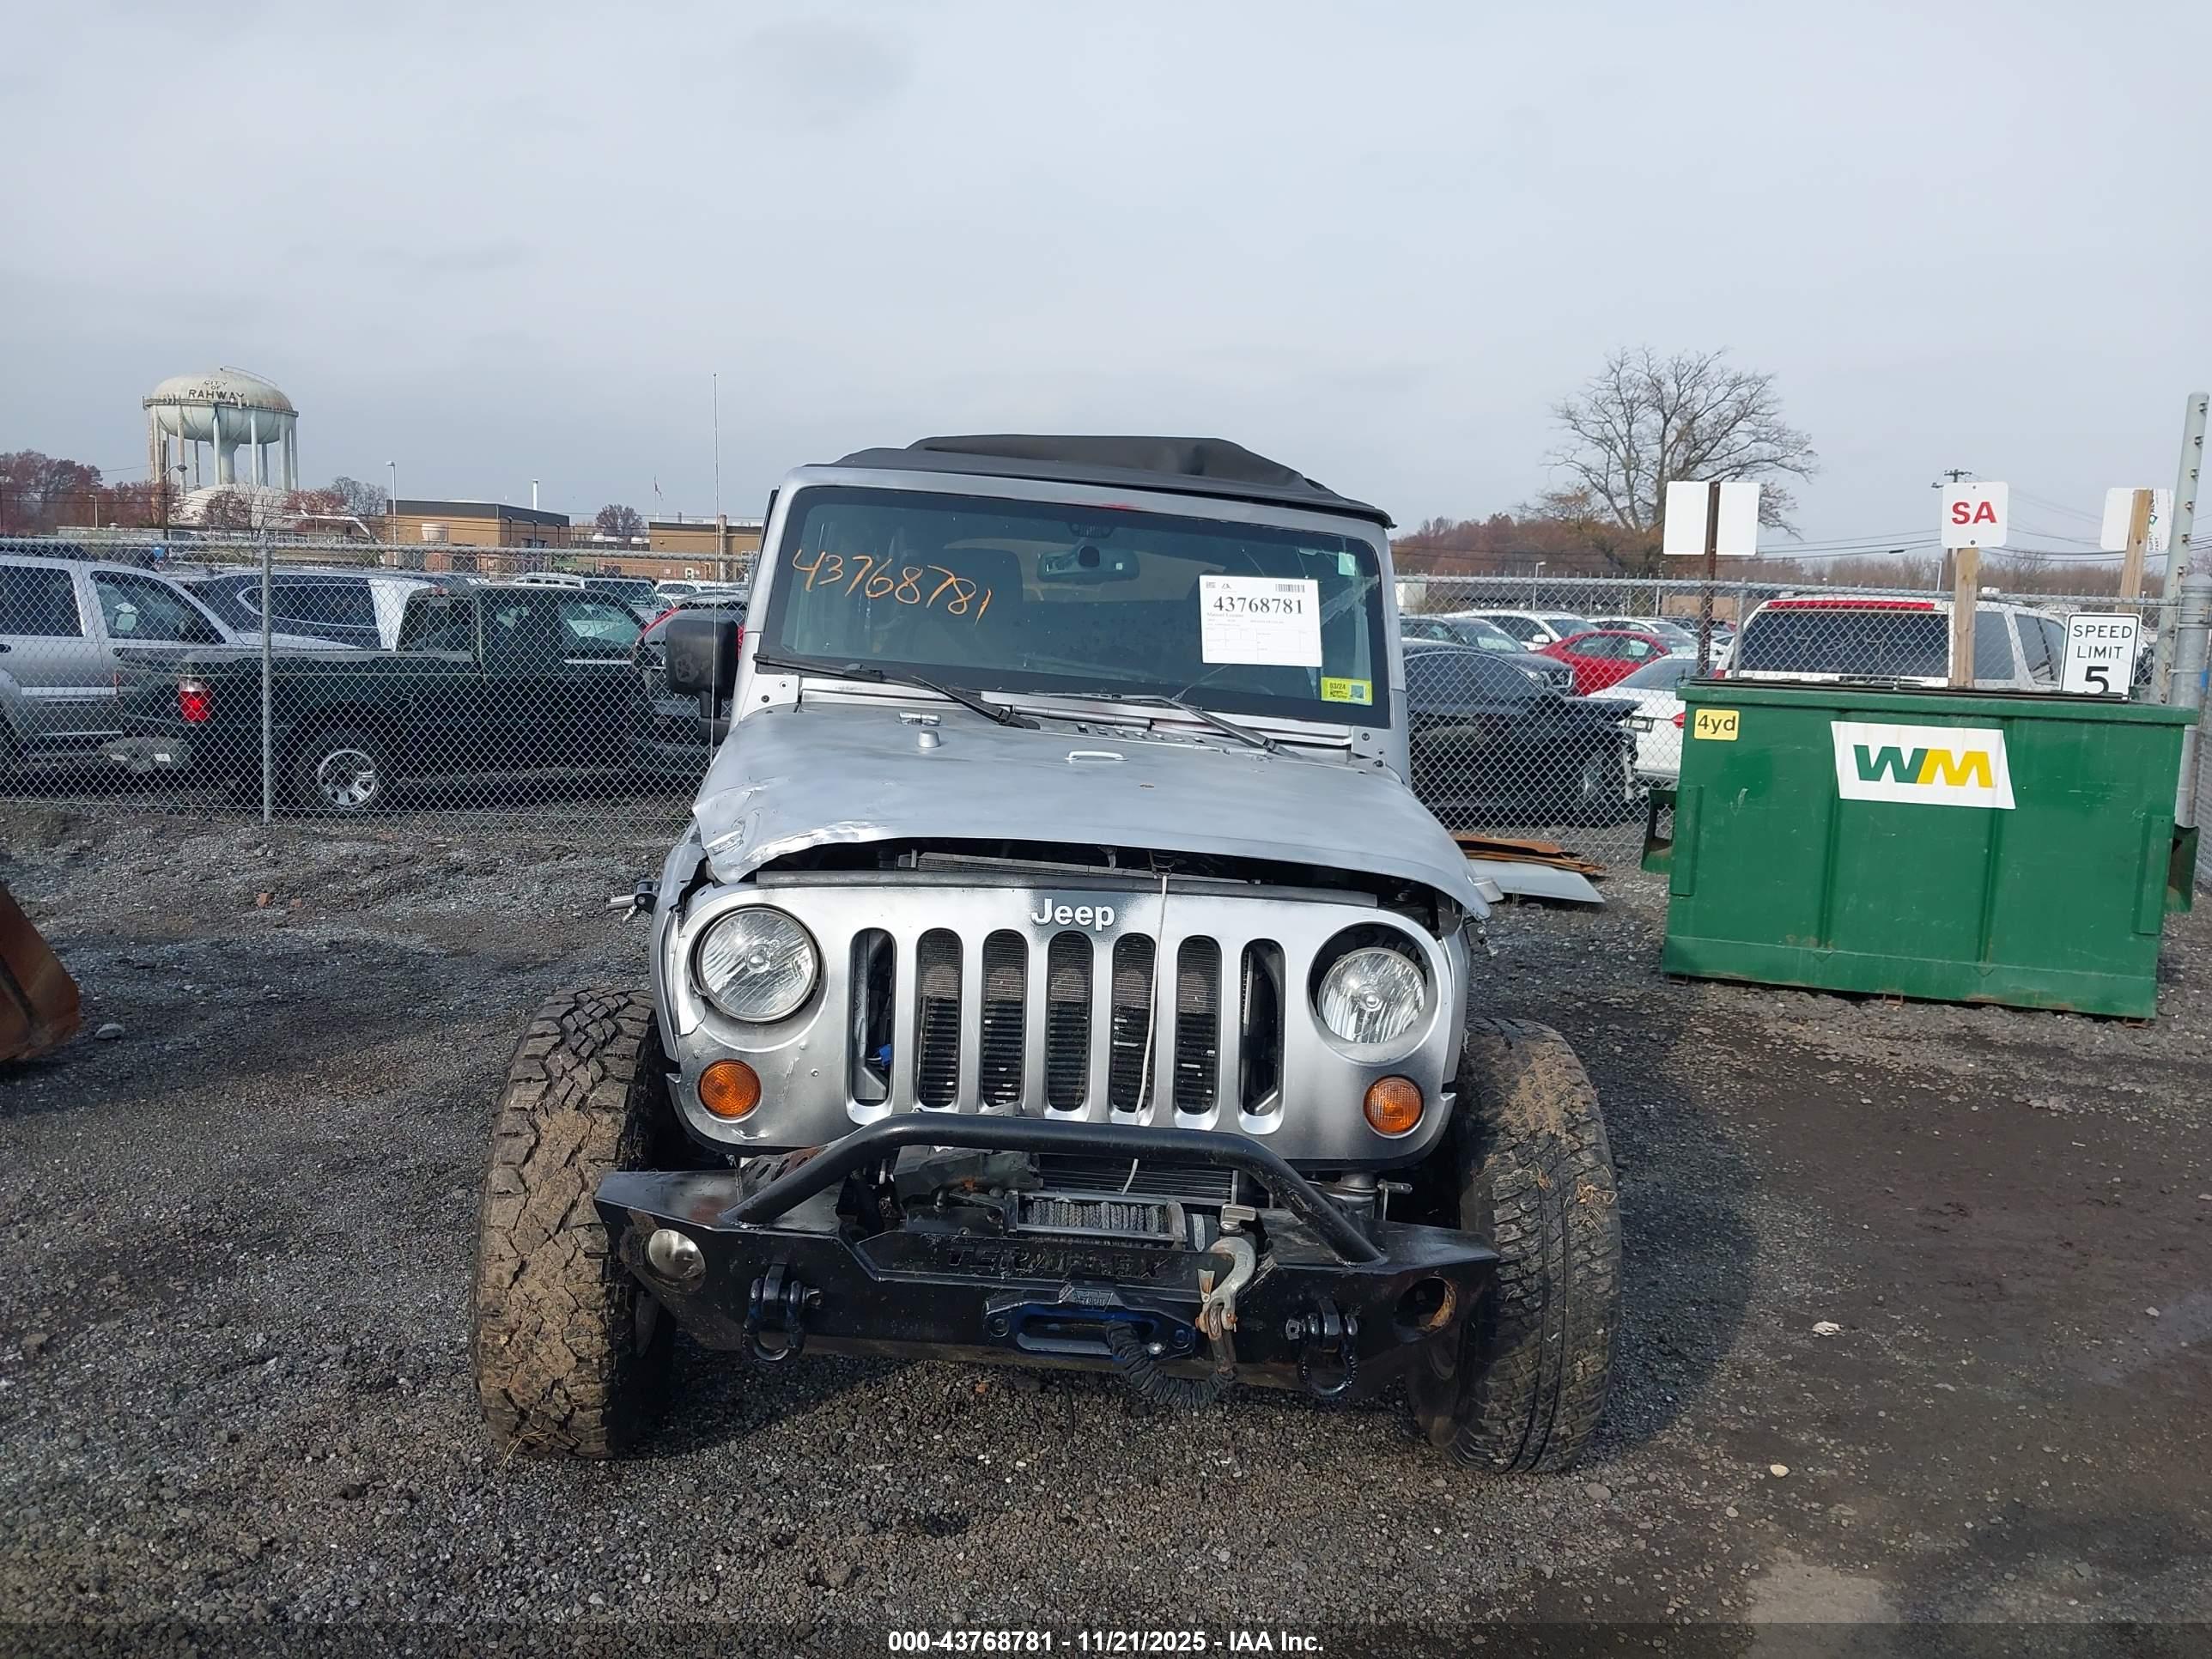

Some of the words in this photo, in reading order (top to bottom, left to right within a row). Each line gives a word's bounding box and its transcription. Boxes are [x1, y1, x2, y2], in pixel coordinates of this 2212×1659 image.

[188, 389, 245, 400] RAHWAY
[1951, 501, 1998, 525] SA
[792, 549, 992, 626] 43768781
[1213, 596, 1304, 615] 43768781
[2073, 624, 2133, 639] SPEED
[2076, 645, 2124, 659] LIMIT
[2085, 665, 2110, 694] 5
[1698, 714, 1736, 735] 4yd
[1853, 744, 1994, 788] WM
[1030, 897, 1115, 932] Jeep
